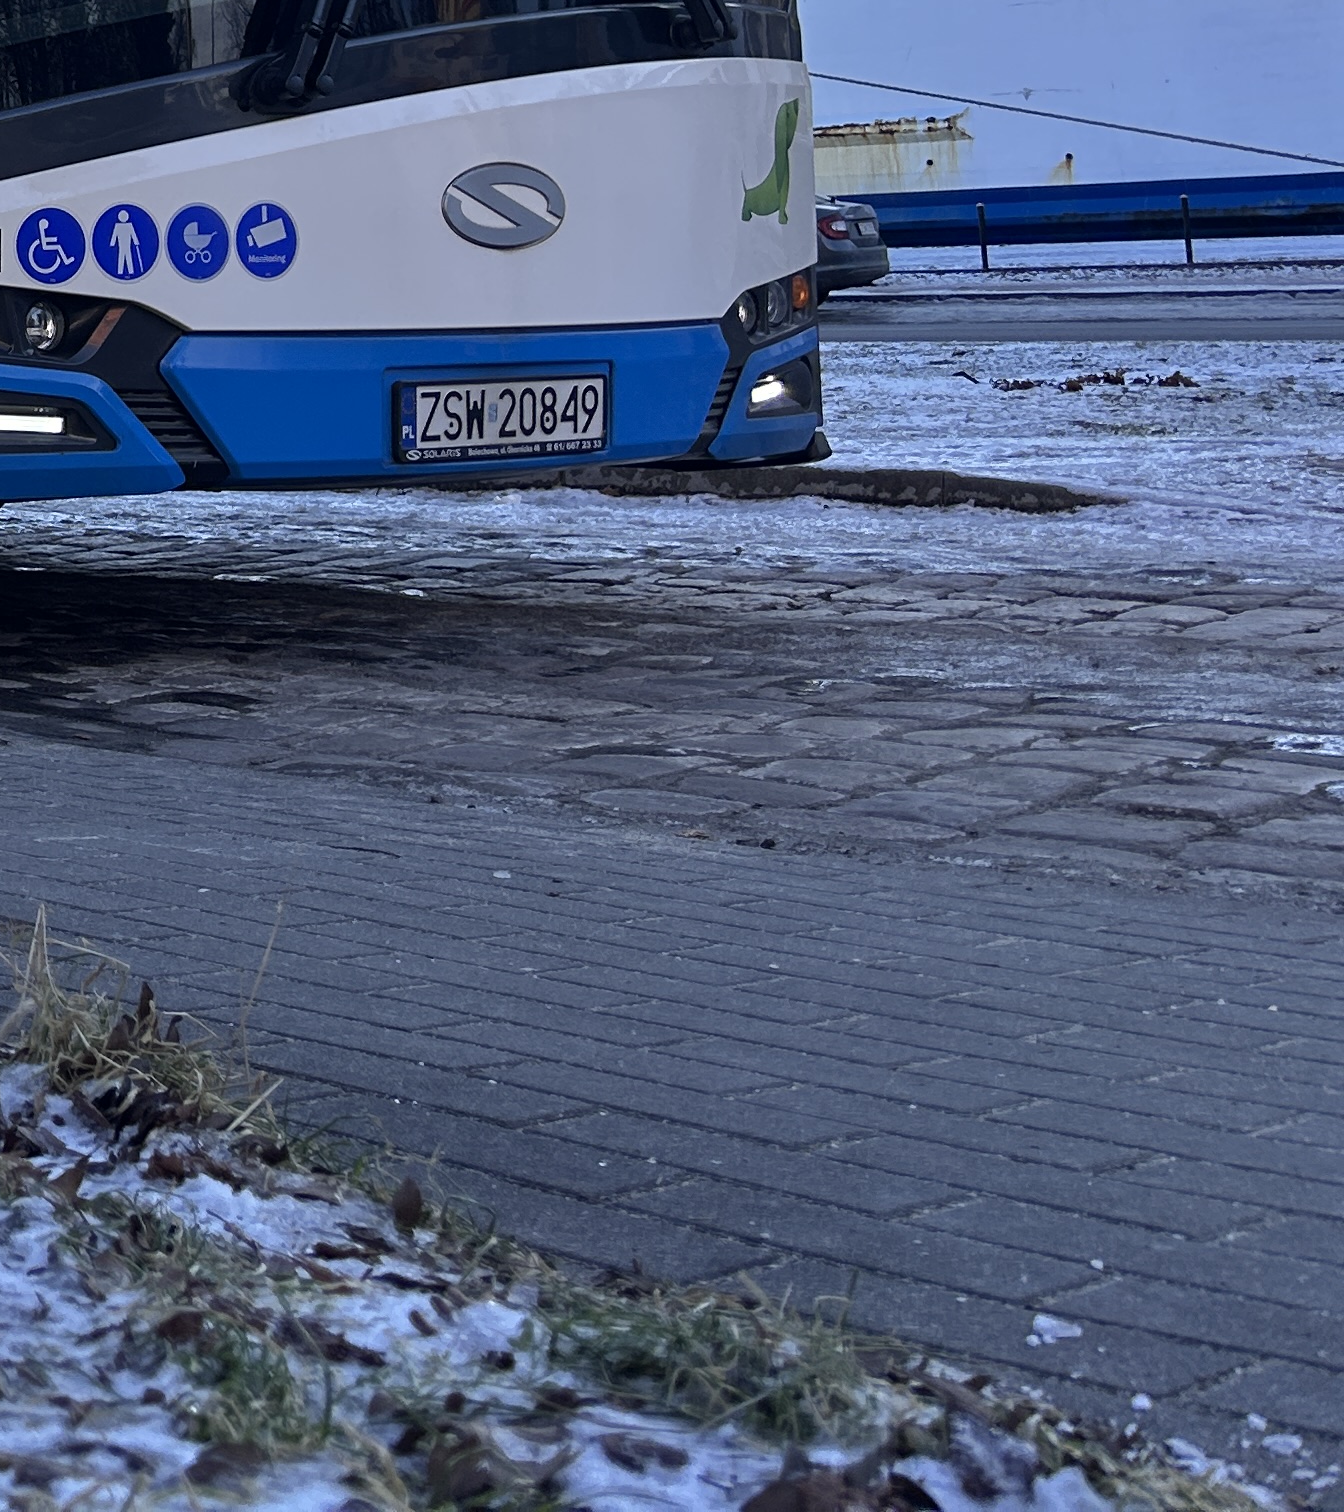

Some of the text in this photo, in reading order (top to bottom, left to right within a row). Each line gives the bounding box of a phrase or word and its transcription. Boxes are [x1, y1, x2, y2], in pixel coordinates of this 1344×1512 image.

[420, 384, 599, 443] ZSW 20849
[401, 425, 415, 440] PL
